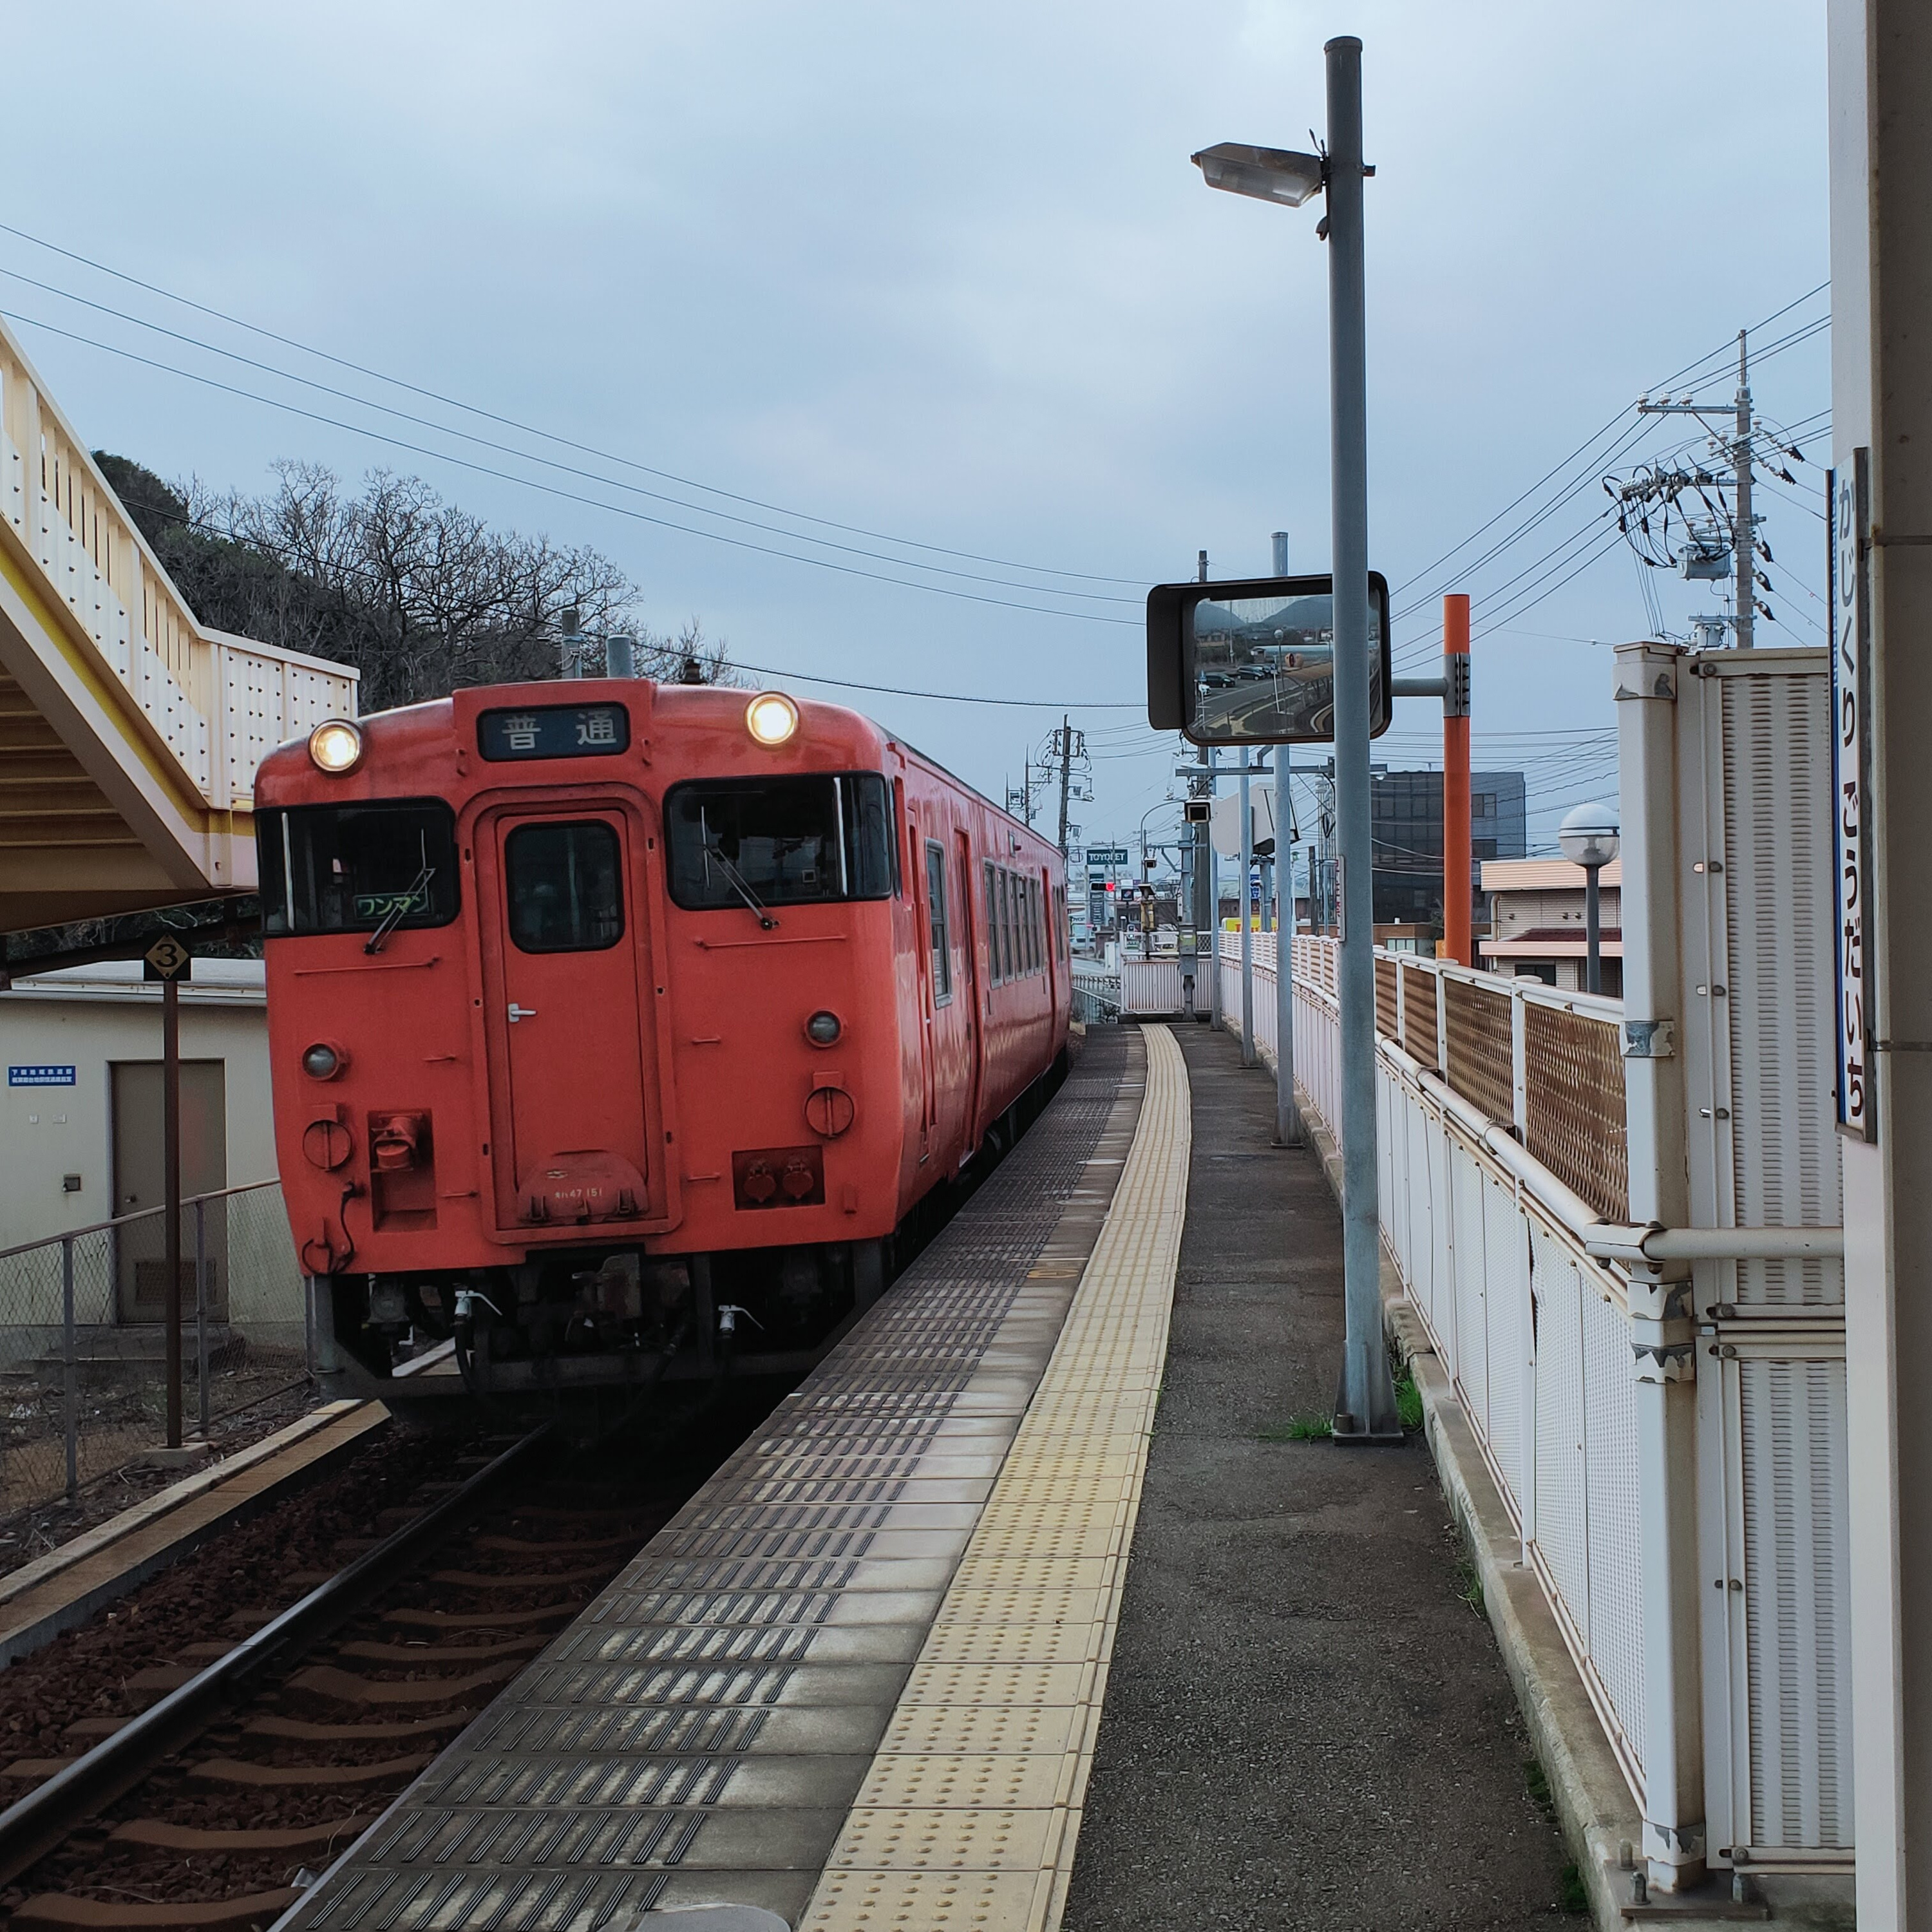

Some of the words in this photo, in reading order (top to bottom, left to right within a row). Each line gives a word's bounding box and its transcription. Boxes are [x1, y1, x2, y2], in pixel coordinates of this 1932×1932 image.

[502, 708, 618, 750] 普通
[1839, 477, 1863, 1117] かじくりごうだいち
[155, 943, 178, 967] 3
